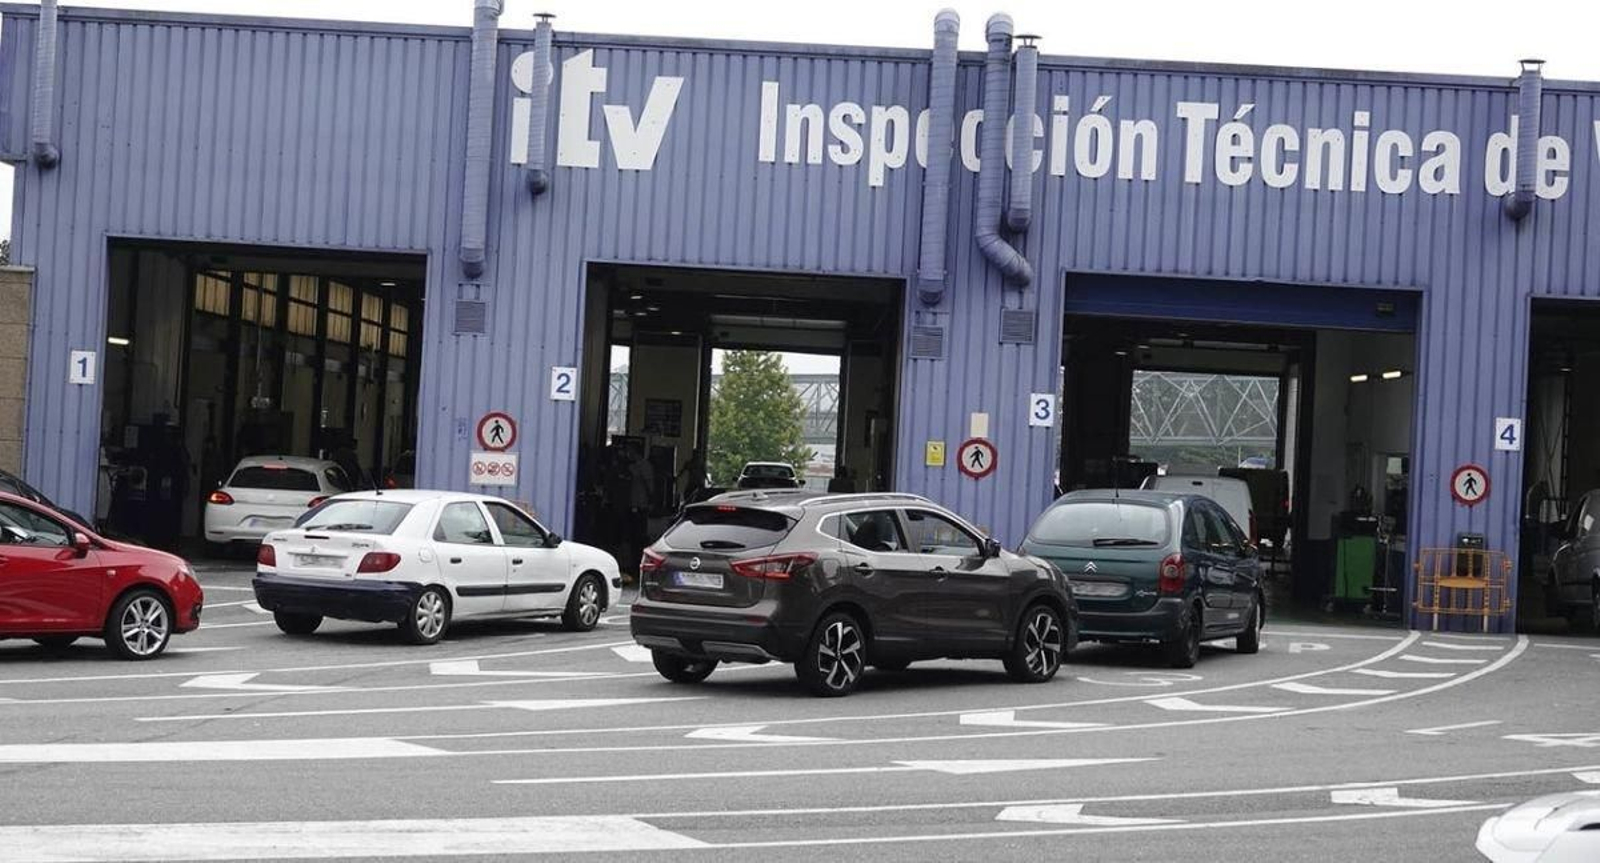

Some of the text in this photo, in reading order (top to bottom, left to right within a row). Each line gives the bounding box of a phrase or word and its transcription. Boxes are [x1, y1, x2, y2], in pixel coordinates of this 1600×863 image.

[1176, 102, 1461, 194] Técnica
[1484, 115, 1571, 200] de
[77, 356, 88, 378] 1
[555, 373, 571, 394] 2
[1034, 398, 1051, 421] 3
[1499, 423, 1517, 446] 4
